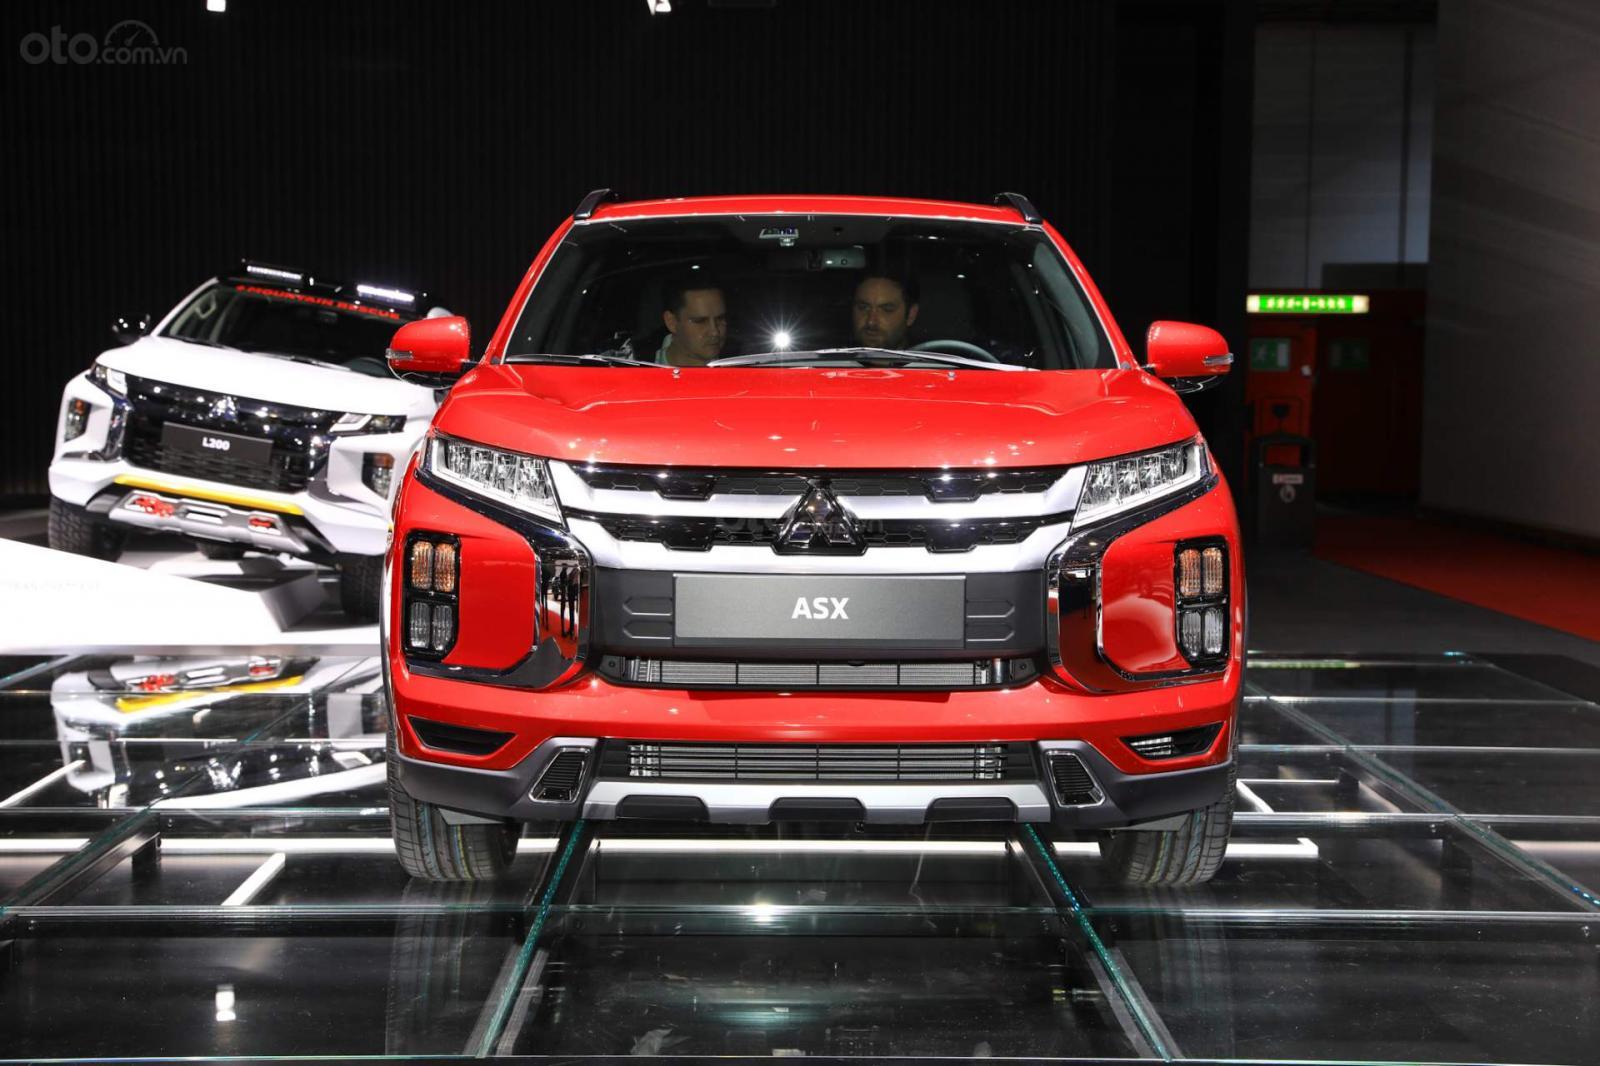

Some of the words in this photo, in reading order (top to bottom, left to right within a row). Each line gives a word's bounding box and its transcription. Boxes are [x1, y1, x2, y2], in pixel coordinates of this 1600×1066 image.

[246, 286, 334, 308] MOUNTAIN
[336, 300, 401, 320] RESCUE
[202, 437, 231, 451] L200
[791, 597, 849, 620] ASX
